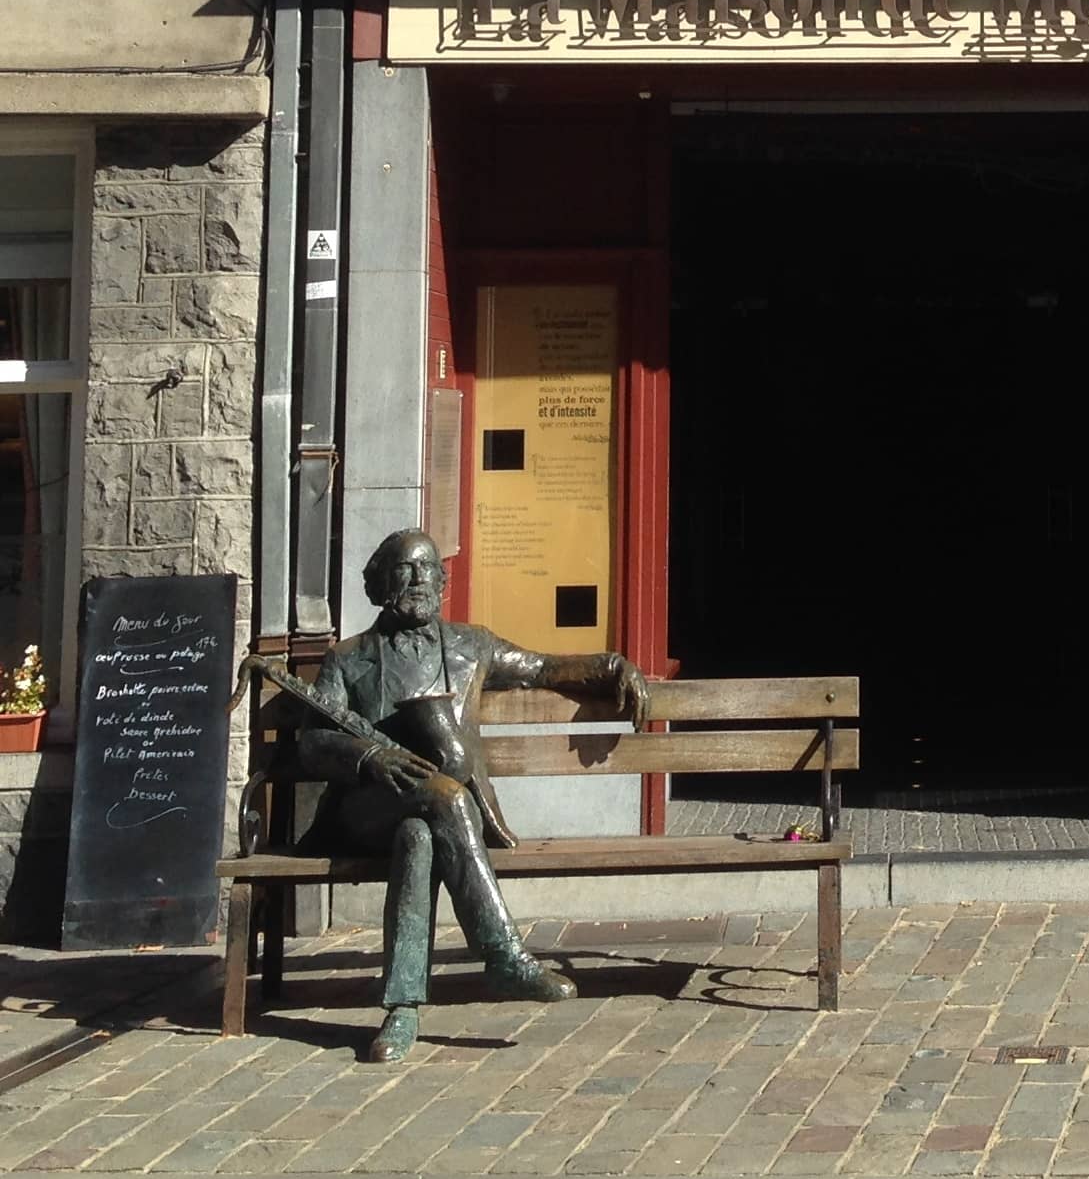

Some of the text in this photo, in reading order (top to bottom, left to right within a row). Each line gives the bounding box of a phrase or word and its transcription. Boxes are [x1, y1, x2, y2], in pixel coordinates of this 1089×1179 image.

[538, 395, 606, 407] plus de force
[538, 406, 548, 418] et
[112, 615, 149, 632] Menu
[153, 612, 169, 627] du
[140, 709, 175, 723] dinde
